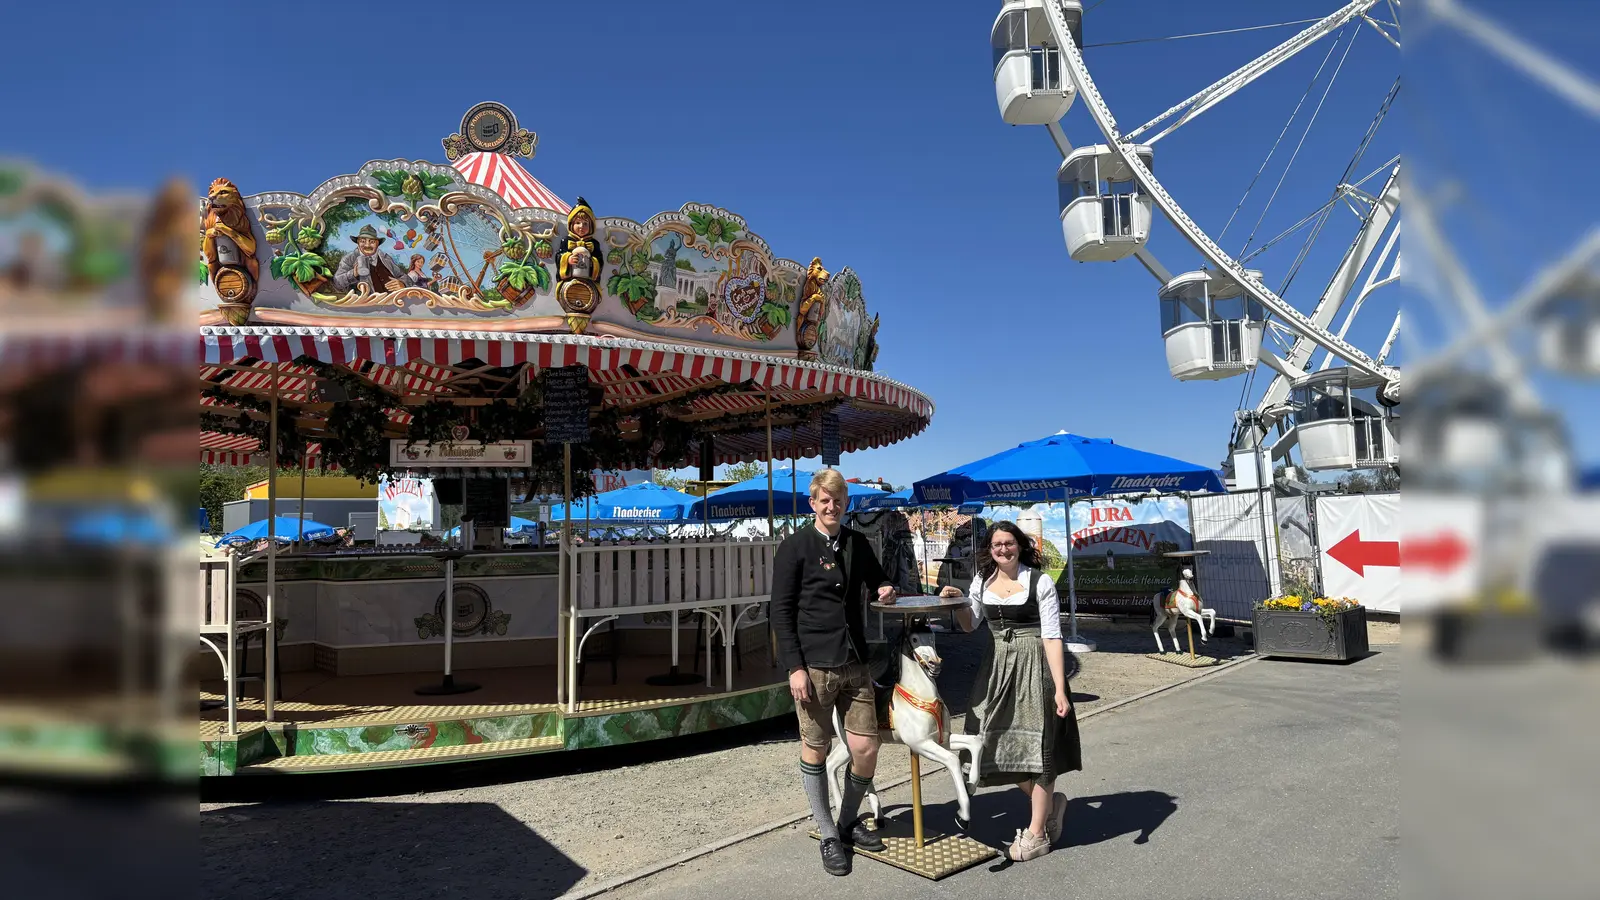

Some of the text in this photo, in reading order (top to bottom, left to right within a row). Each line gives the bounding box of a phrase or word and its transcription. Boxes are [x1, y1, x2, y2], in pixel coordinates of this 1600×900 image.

[590, 474, 628, 493] URA
[987, 479, 1069, 493] Naabecker
[1111, 474, 1185, 489] Naabecker
[385, 479, 425, 501] WEIZEN
[612, 506, 662, 518] Naabecker
[711, 504, 756, 518] Naabecker
[1088, 506, 1134, 527] JURA
[1070, 526, 1155, 552] WEIZEN
[1078, 574, 1104, 585] frische
[1106, 574, 1138, 585] Schluck
[1141, 574, 1172, 585] Heimat
[1059, 596, 1069, 605] uf
[1076, 597, 1089, 606] as,
[1091, 597, 1109, 605] was
[1111, 596, 1130, 605] wir
